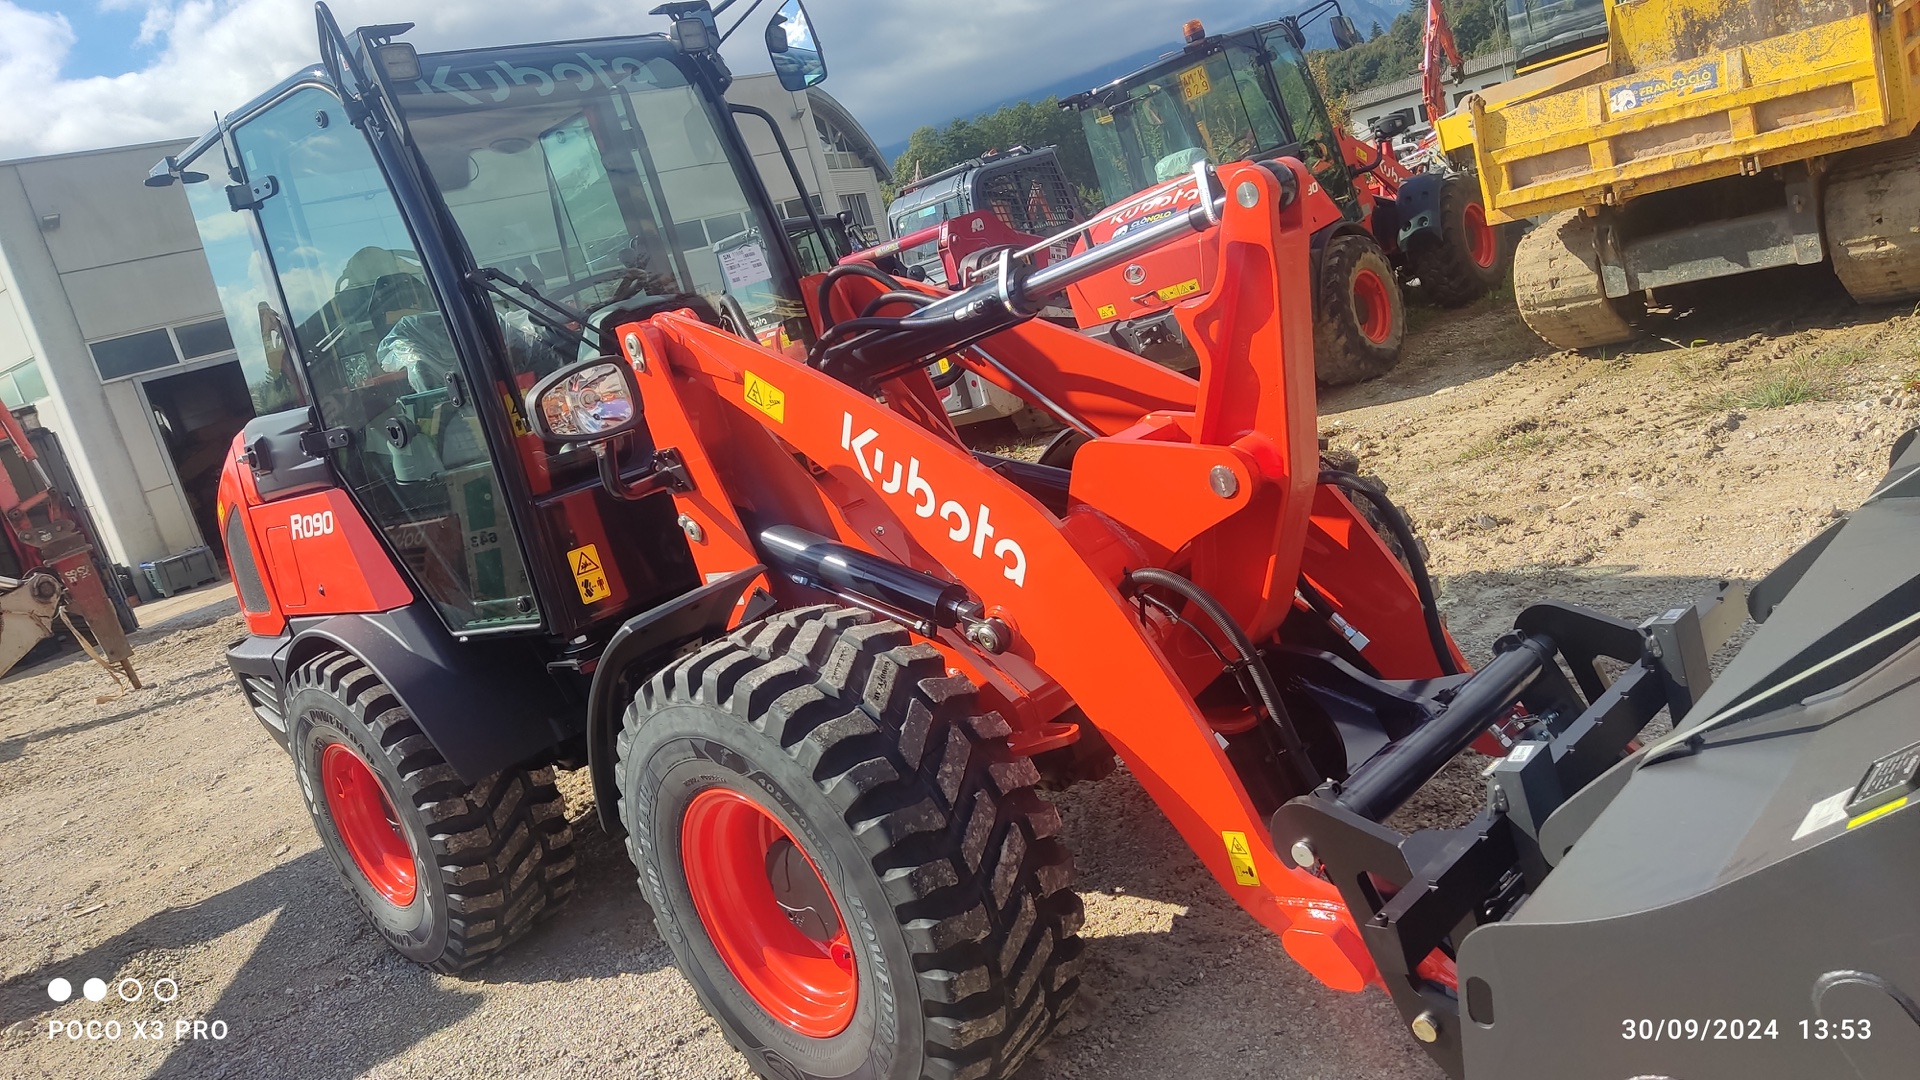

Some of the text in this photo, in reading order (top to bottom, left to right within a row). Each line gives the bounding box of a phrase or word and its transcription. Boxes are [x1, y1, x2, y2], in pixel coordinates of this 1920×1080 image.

[414, 52, 659, 106] Kubota
[1186, 80, 1209, 98] 829
[1197, 68, 1205, 81] K
[1638, 78, 1687, 97] FRANCO
[1109, 187, 1199, 226] Kubota
[841, 410, 1028, 589] Kubota
[290, 510, 334, 541] R090
[846, 894, 897, 1075] POWERLOAD
